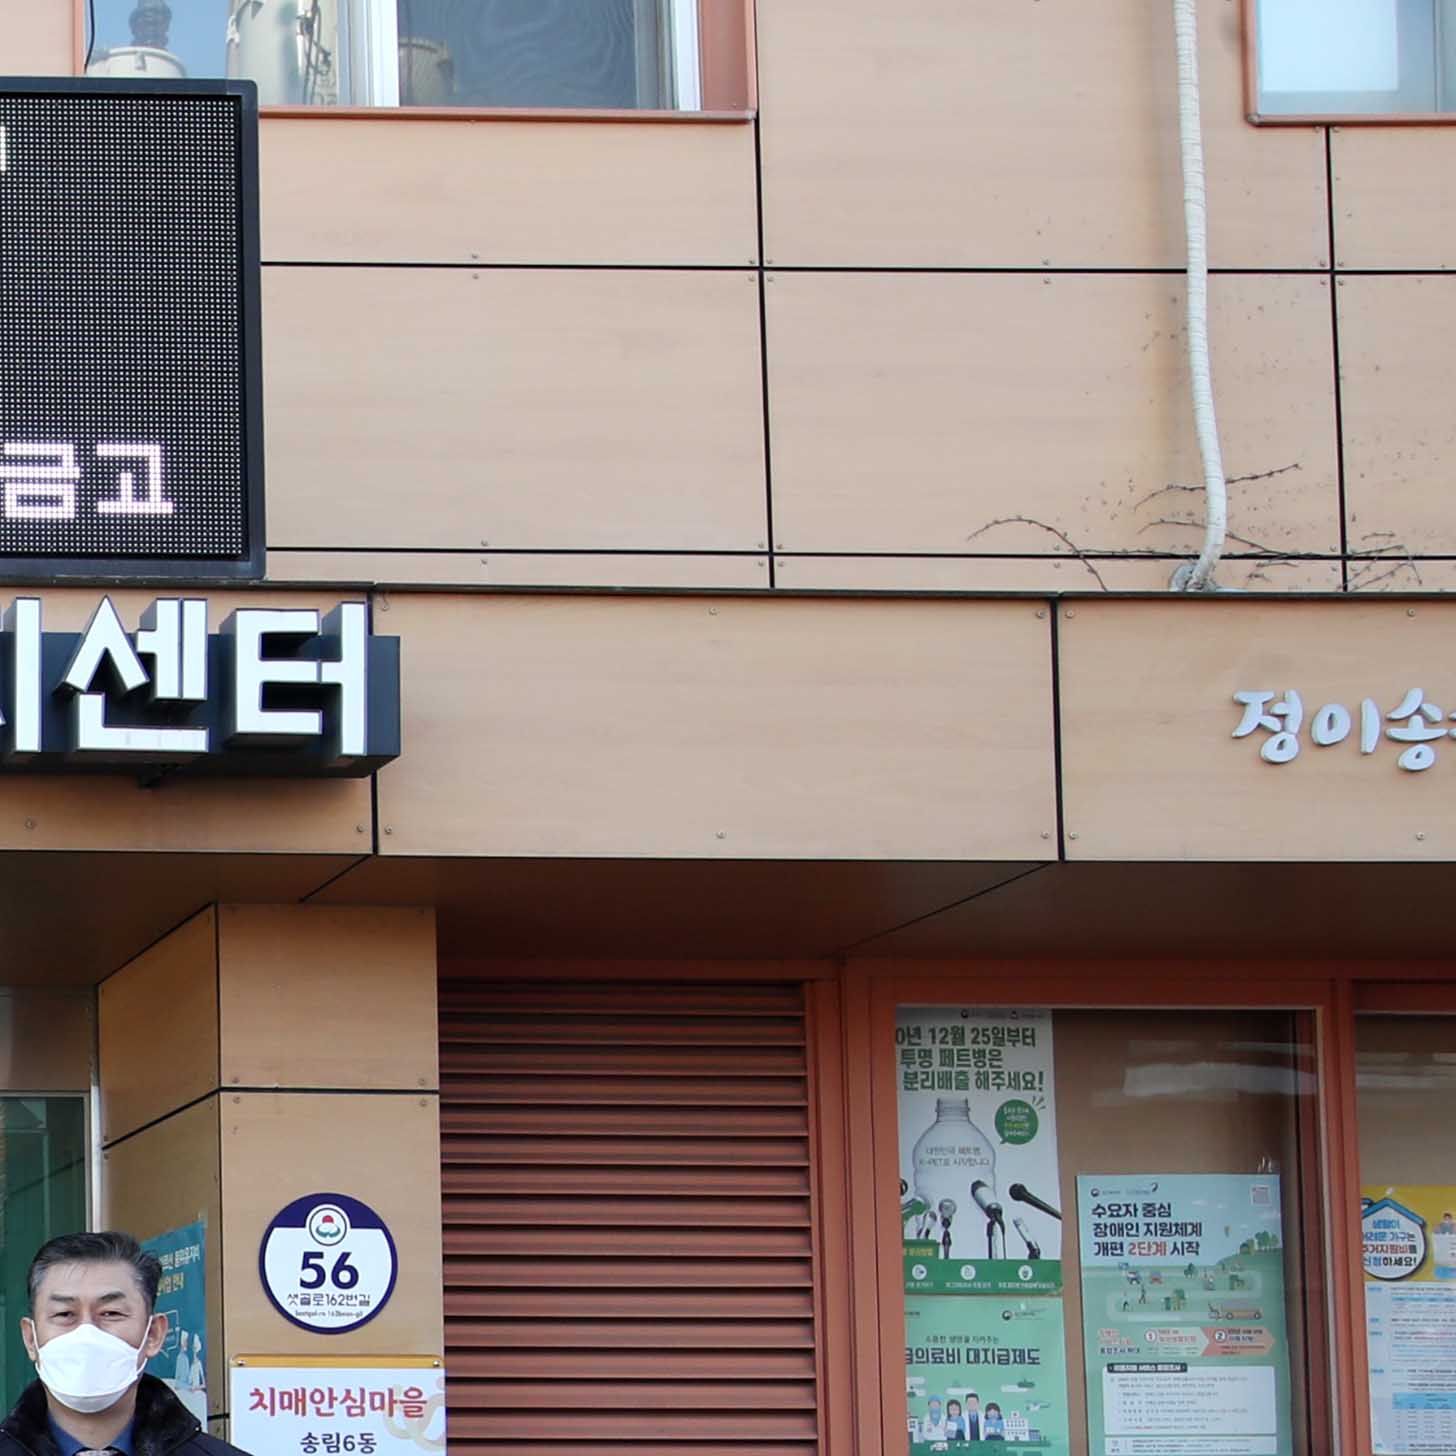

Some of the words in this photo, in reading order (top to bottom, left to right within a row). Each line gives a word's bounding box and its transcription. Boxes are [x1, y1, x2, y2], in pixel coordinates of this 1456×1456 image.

[1232, 687, 1456, 772] 정이송
[927, 1025, 965, 1047] 12월
[970, 1025, 1036, 1048] 25일부터
[900, 1048, 933, 1069] 투명
[939, 1048, 1002, 1069] 페트병은
[903, 1071, 969, 1092] 분리배출
[975, 1070, 1044, 1092] 해주세요!
[1091, 1202, 1138, 1219] 수요자
[1142, 1202, 1172, 1219] 중심
[1092, 1222, 1139, 1238] 장애인
[1143, 1222, 1203, 1238] 지원체계
[1093, 1241, 1125, 1257] 개편
[1128, 1241, 1167, 1257] 2단계
[1170, 1241, 1201, 1257] 시작
[299, 1251, 359, 1290] 56
[966, 1347, 1041, 1366] 대지급제도
[249, 1386, 428, 1419] 치매안심마을
[300, 1431, 377, 1454] 송림6동
